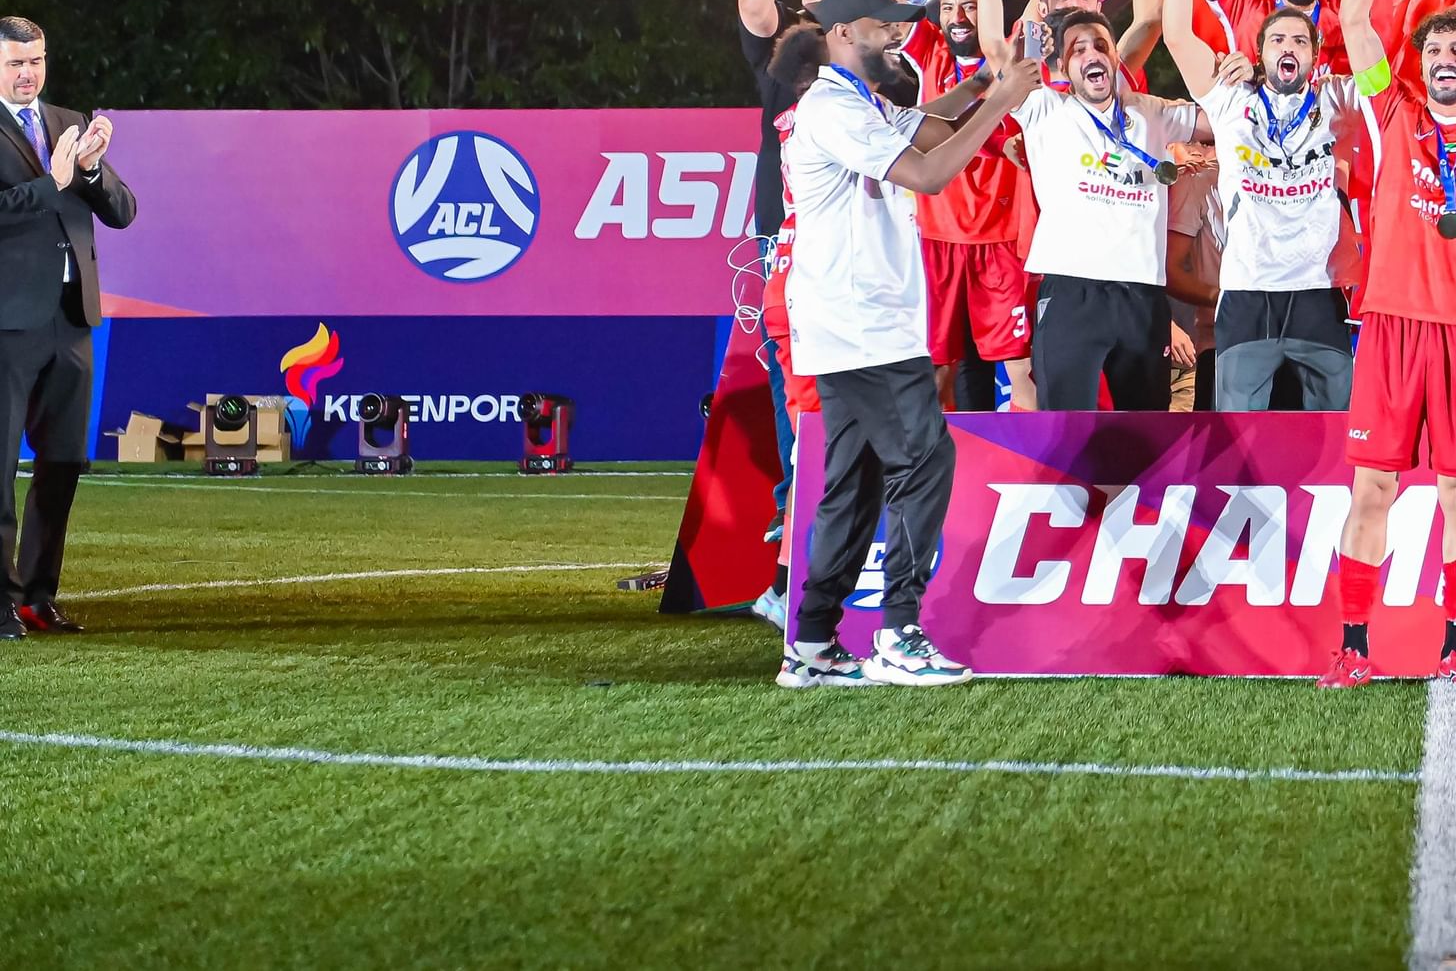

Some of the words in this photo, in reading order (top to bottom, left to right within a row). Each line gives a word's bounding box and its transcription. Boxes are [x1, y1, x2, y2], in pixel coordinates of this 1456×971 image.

[428, 203, 500, 235] ACL
[575, 152, 757, 239] ASI
[1011, 305, 1026, 338] 3
